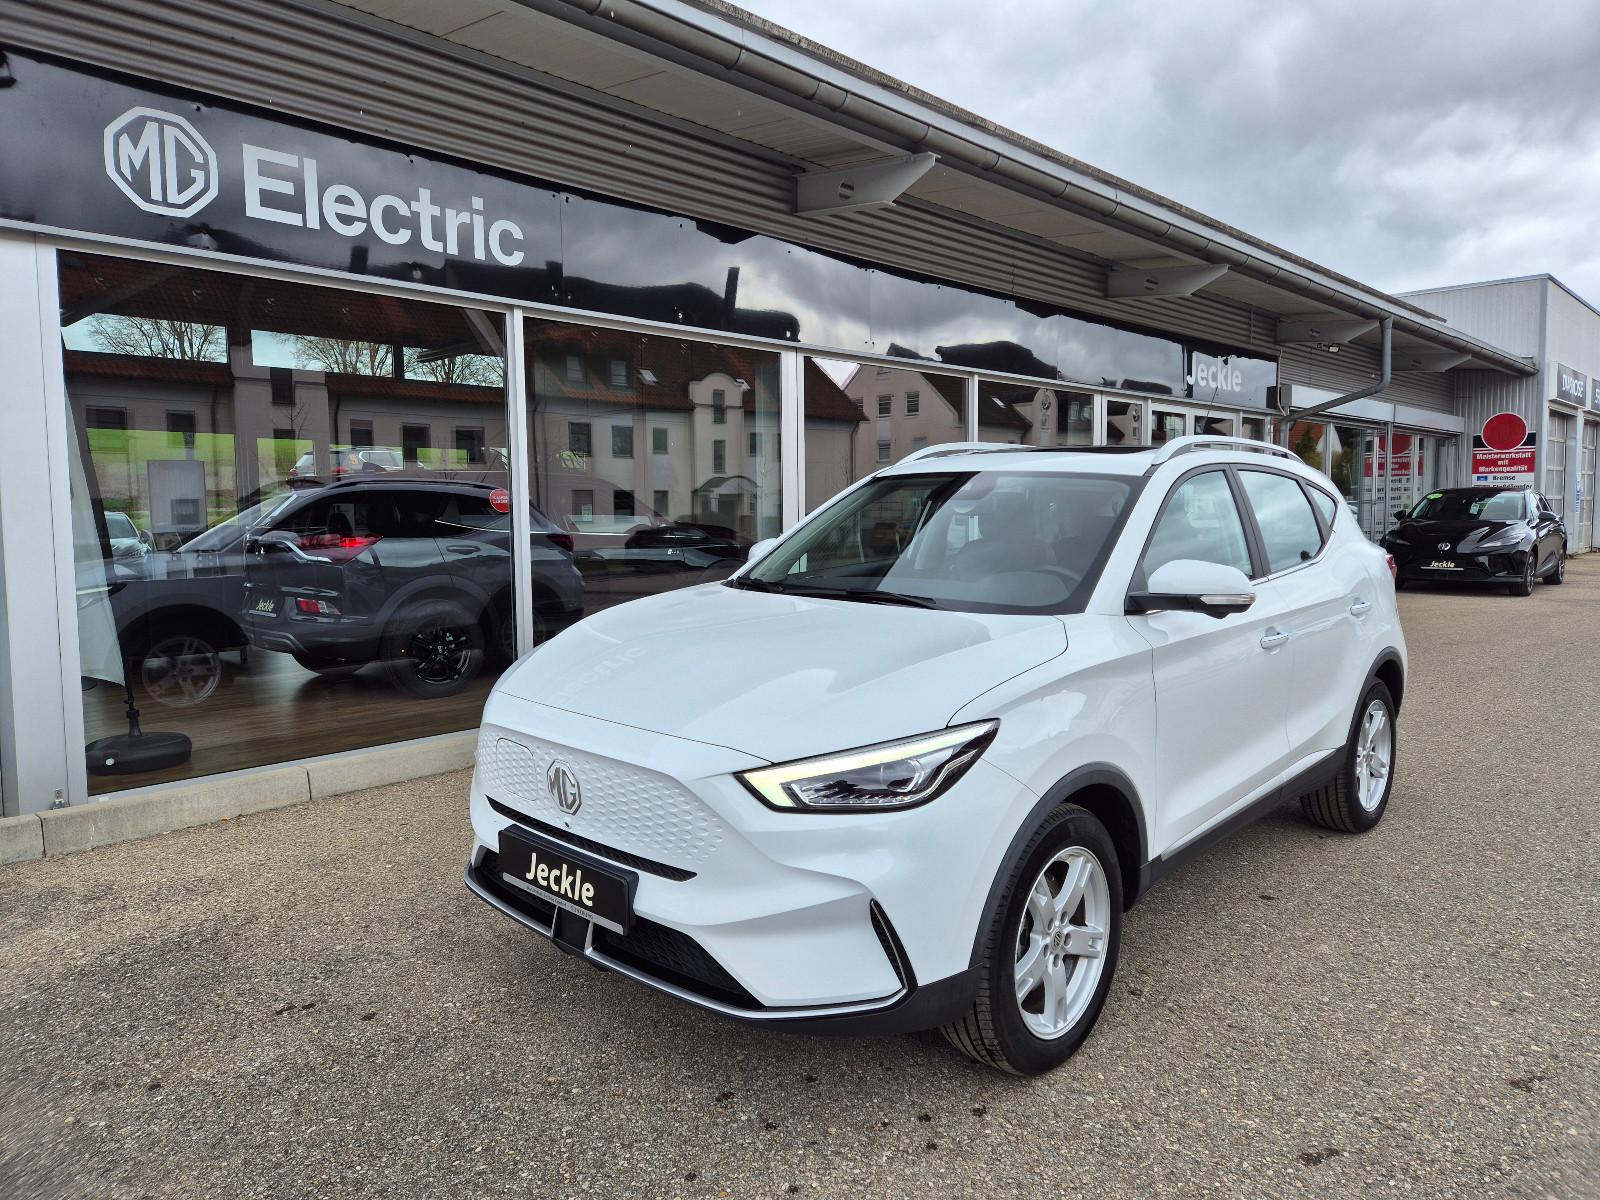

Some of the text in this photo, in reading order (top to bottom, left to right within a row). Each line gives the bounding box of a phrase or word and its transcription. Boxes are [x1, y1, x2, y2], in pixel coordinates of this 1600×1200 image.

[116, 118, 525, 267] MG Electric
[1186, 351, 1242, 392] Jeckle
[1476, 452, 1531, 460] Meisterwerkstatt
[1430, 560, 1456, 568] Jeckle
[548, 765, 579, 810] MG
[525, 852, 595, 907] Jeckle
